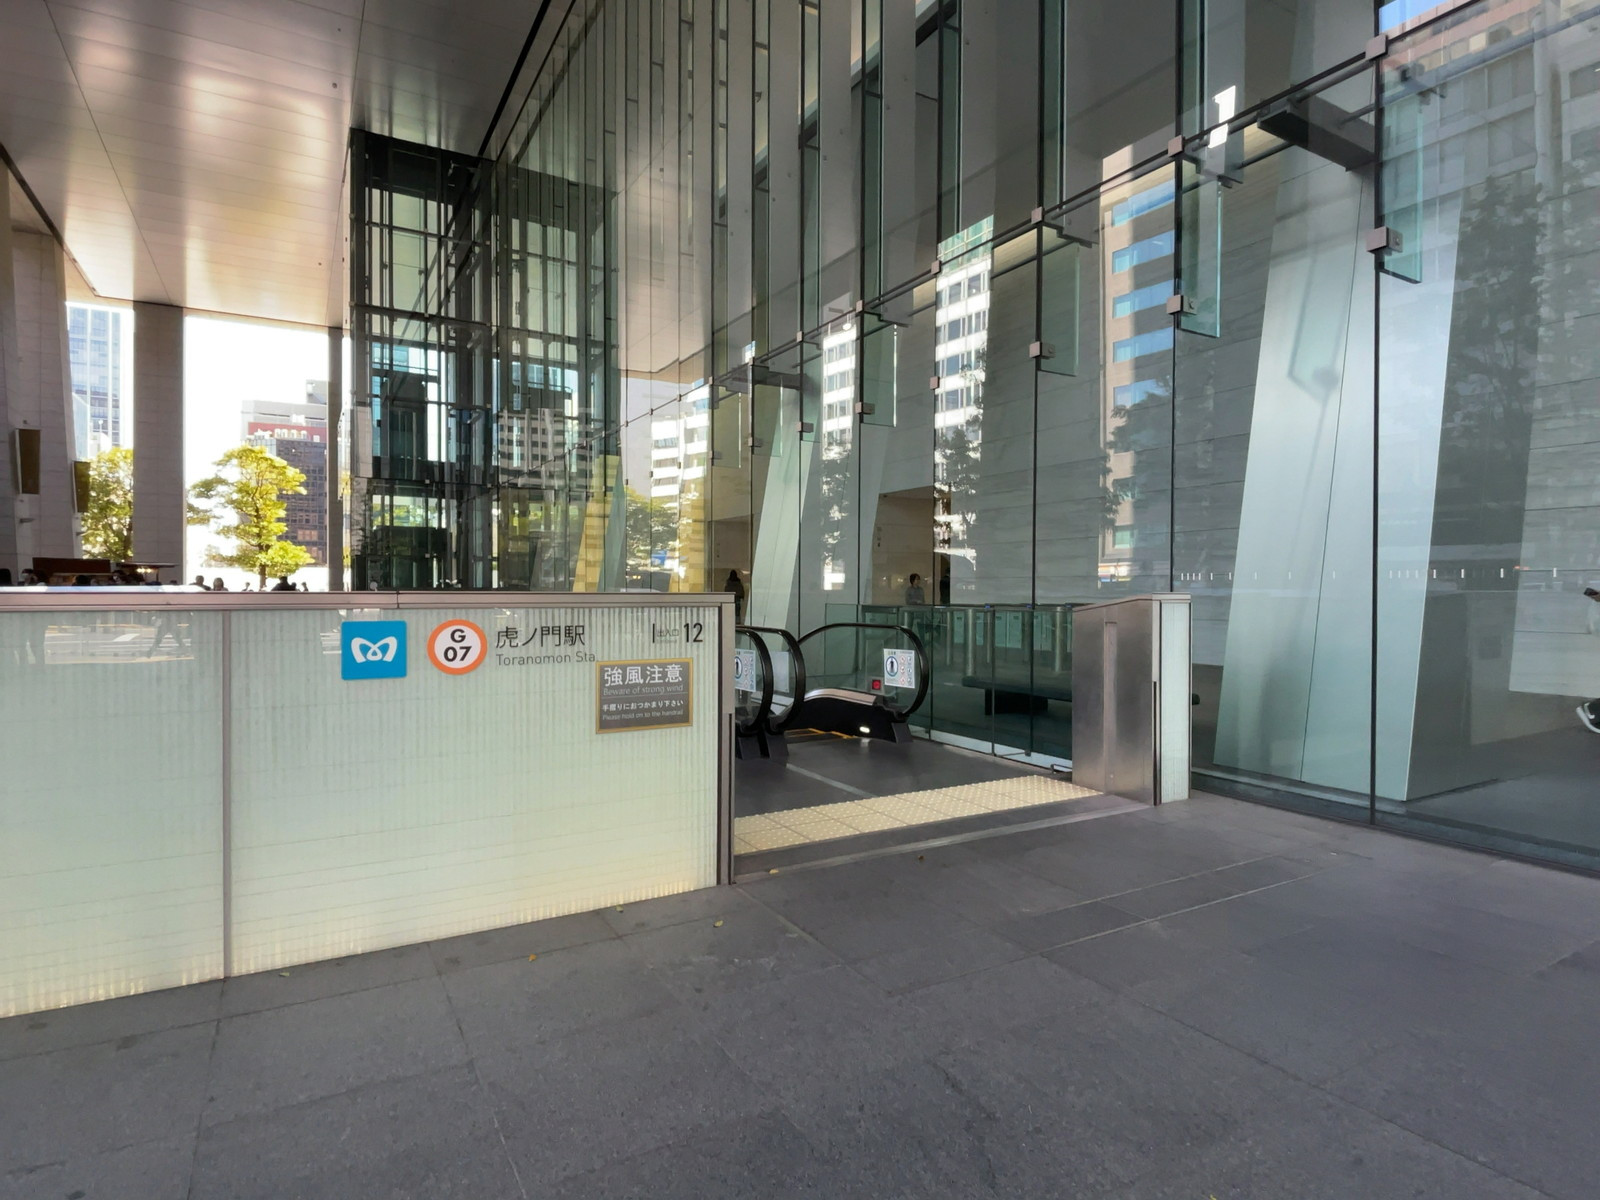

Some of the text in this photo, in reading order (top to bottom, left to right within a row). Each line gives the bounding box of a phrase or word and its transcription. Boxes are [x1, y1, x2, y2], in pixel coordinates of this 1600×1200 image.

[451, 628, 467, 643] G
[496, 625, 585, 648] 虎ノ門駅
[684, 623, 704, 643] 12
[443, 646, 473, 662] 07
[496, 653, 571, 666] Toranomon
[604, 664, 683, 687] 強風注意
[603, 684, 684, 696] Beware of strong wind
